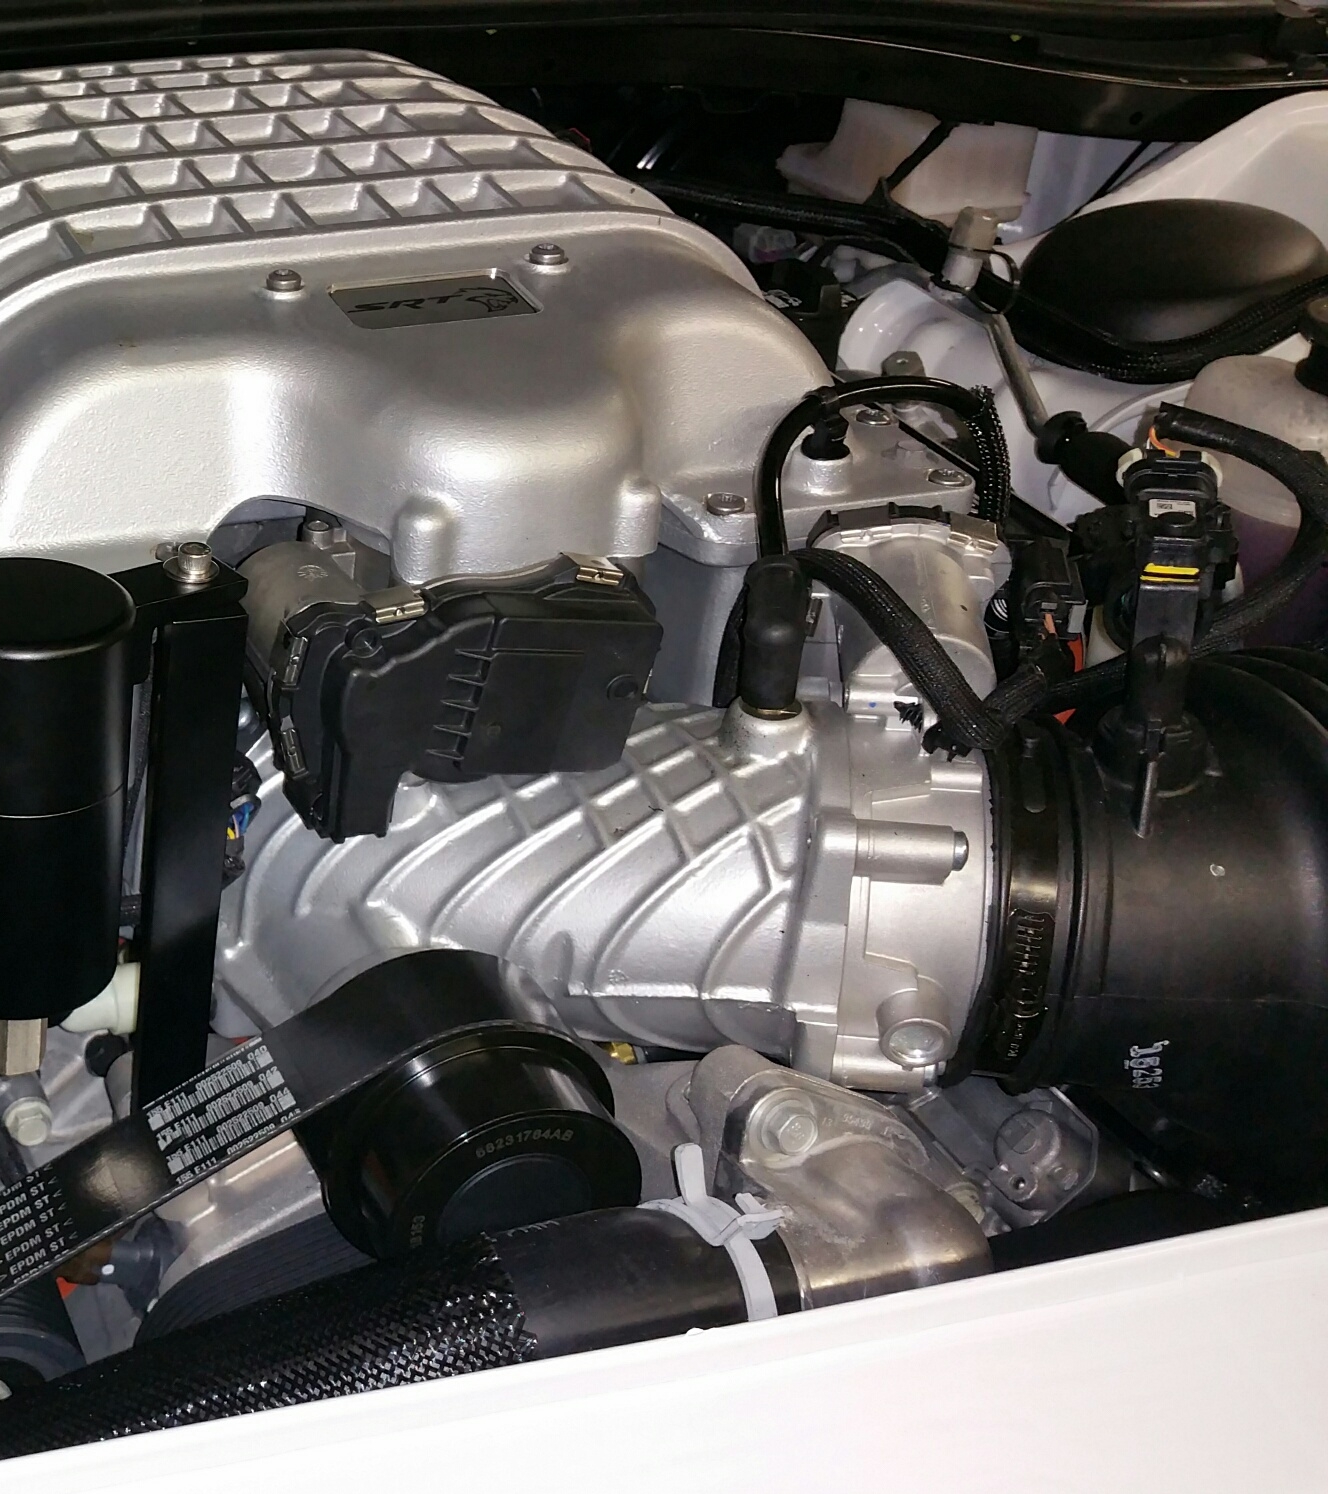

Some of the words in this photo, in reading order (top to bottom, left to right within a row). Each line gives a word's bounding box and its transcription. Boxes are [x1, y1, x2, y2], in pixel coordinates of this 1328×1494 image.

[347, 294, 463, 314] SRT
[258, 1066, 278, 1081] 042
[269, 1086, 291, 1103] 044
[29, 1181, 45, 1196] ST
[34, 1194, 50, 1209] ST
[0, 1219, 36, 1246] EPDM
[38, 1207, 54, 1223] ST
[4, 1234, 42, 1262] EPDM
[44, 1222, 60, 1238] ST
[9, 1248, 46, 1275] EPDM
[49, 1236, 66, 1252] ST
